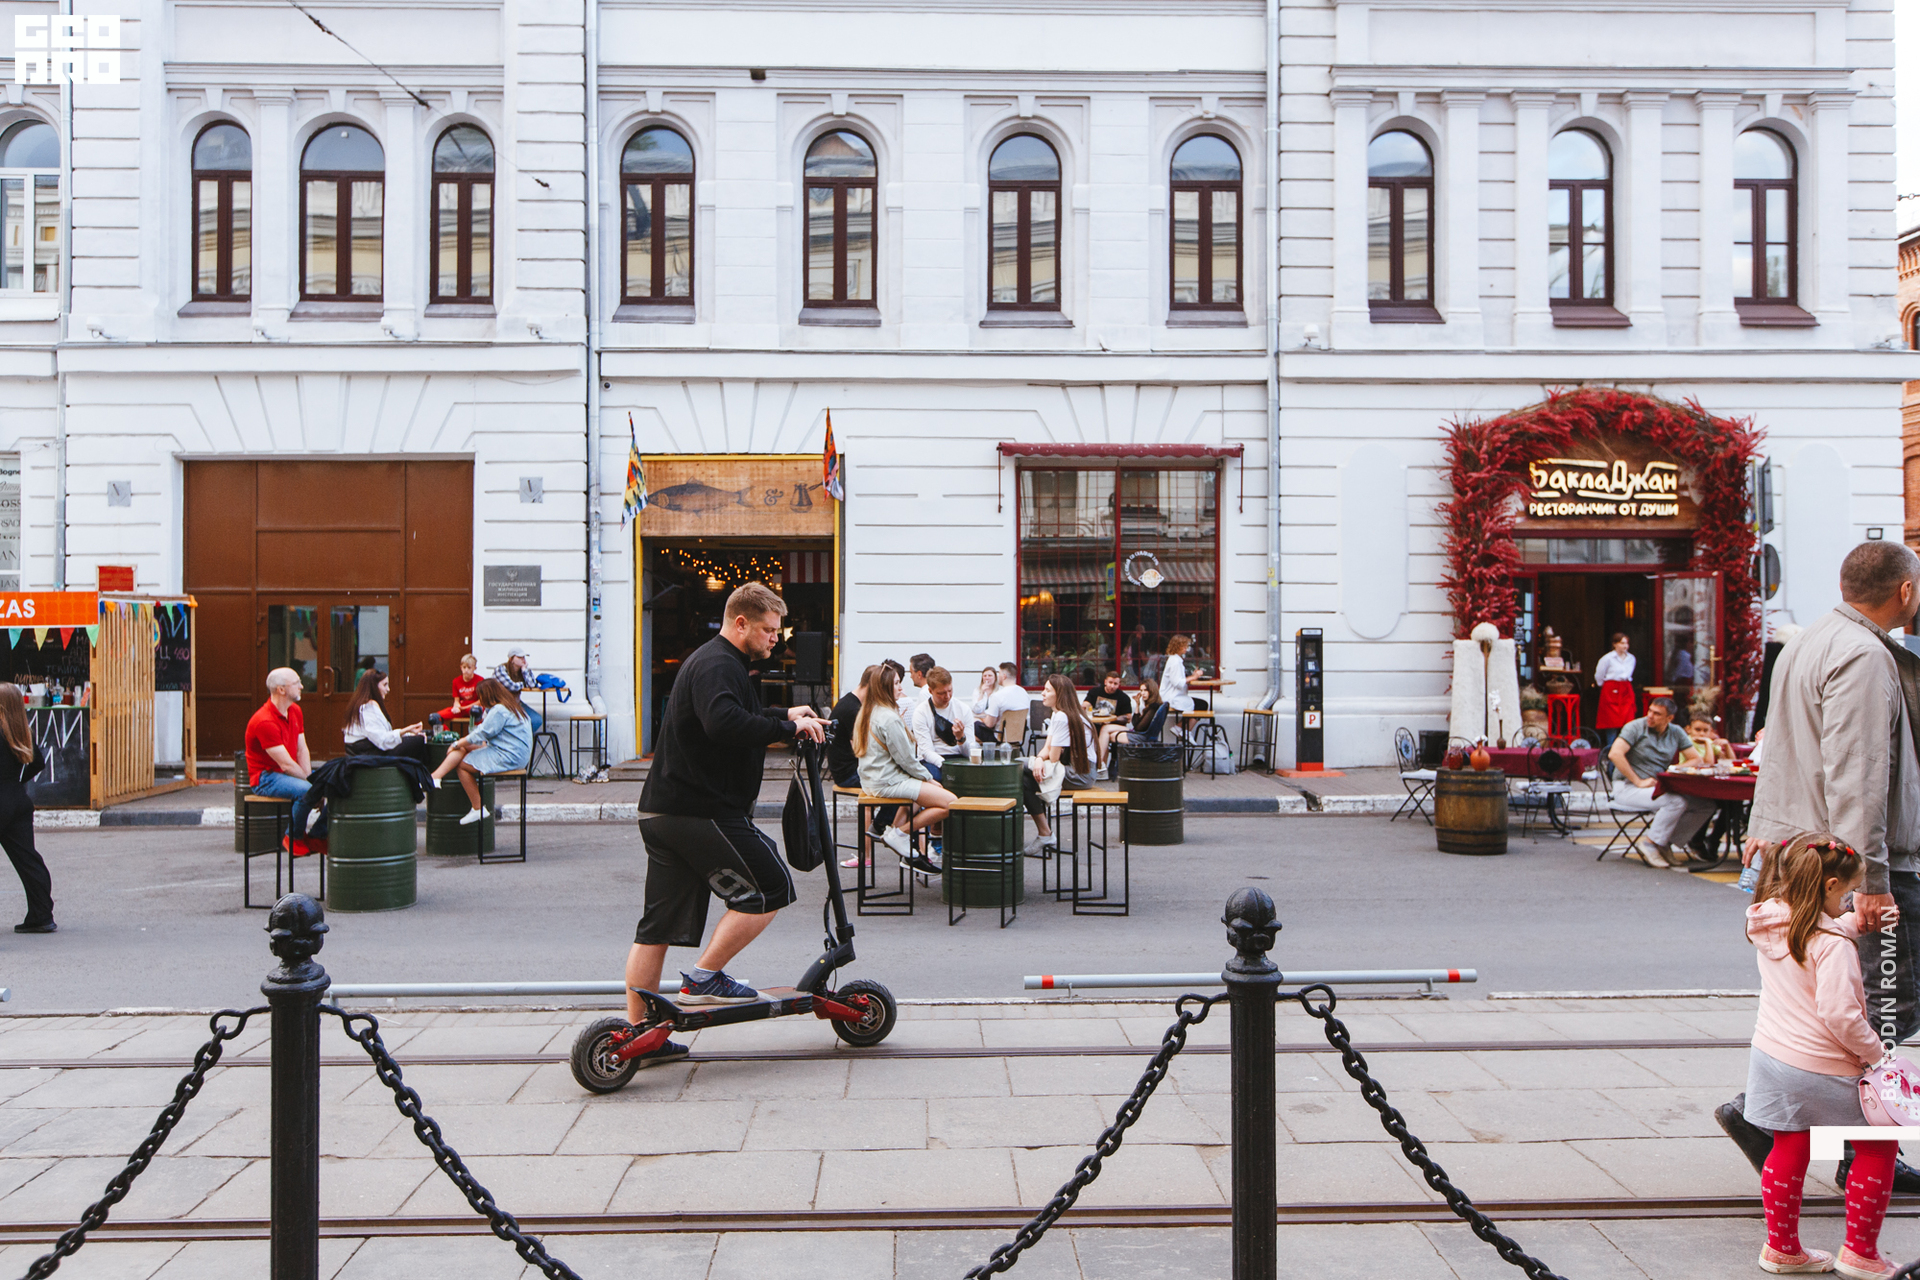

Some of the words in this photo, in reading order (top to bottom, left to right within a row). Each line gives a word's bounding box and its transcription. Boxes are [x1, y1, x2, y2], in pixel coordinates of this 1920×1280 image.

[1529, 503, 1616, 516] РЕСТОРАНЧИК
[1619, 503, 1636, 516] ОТ
[1639, 503, 1679, 516] ДУШИ
